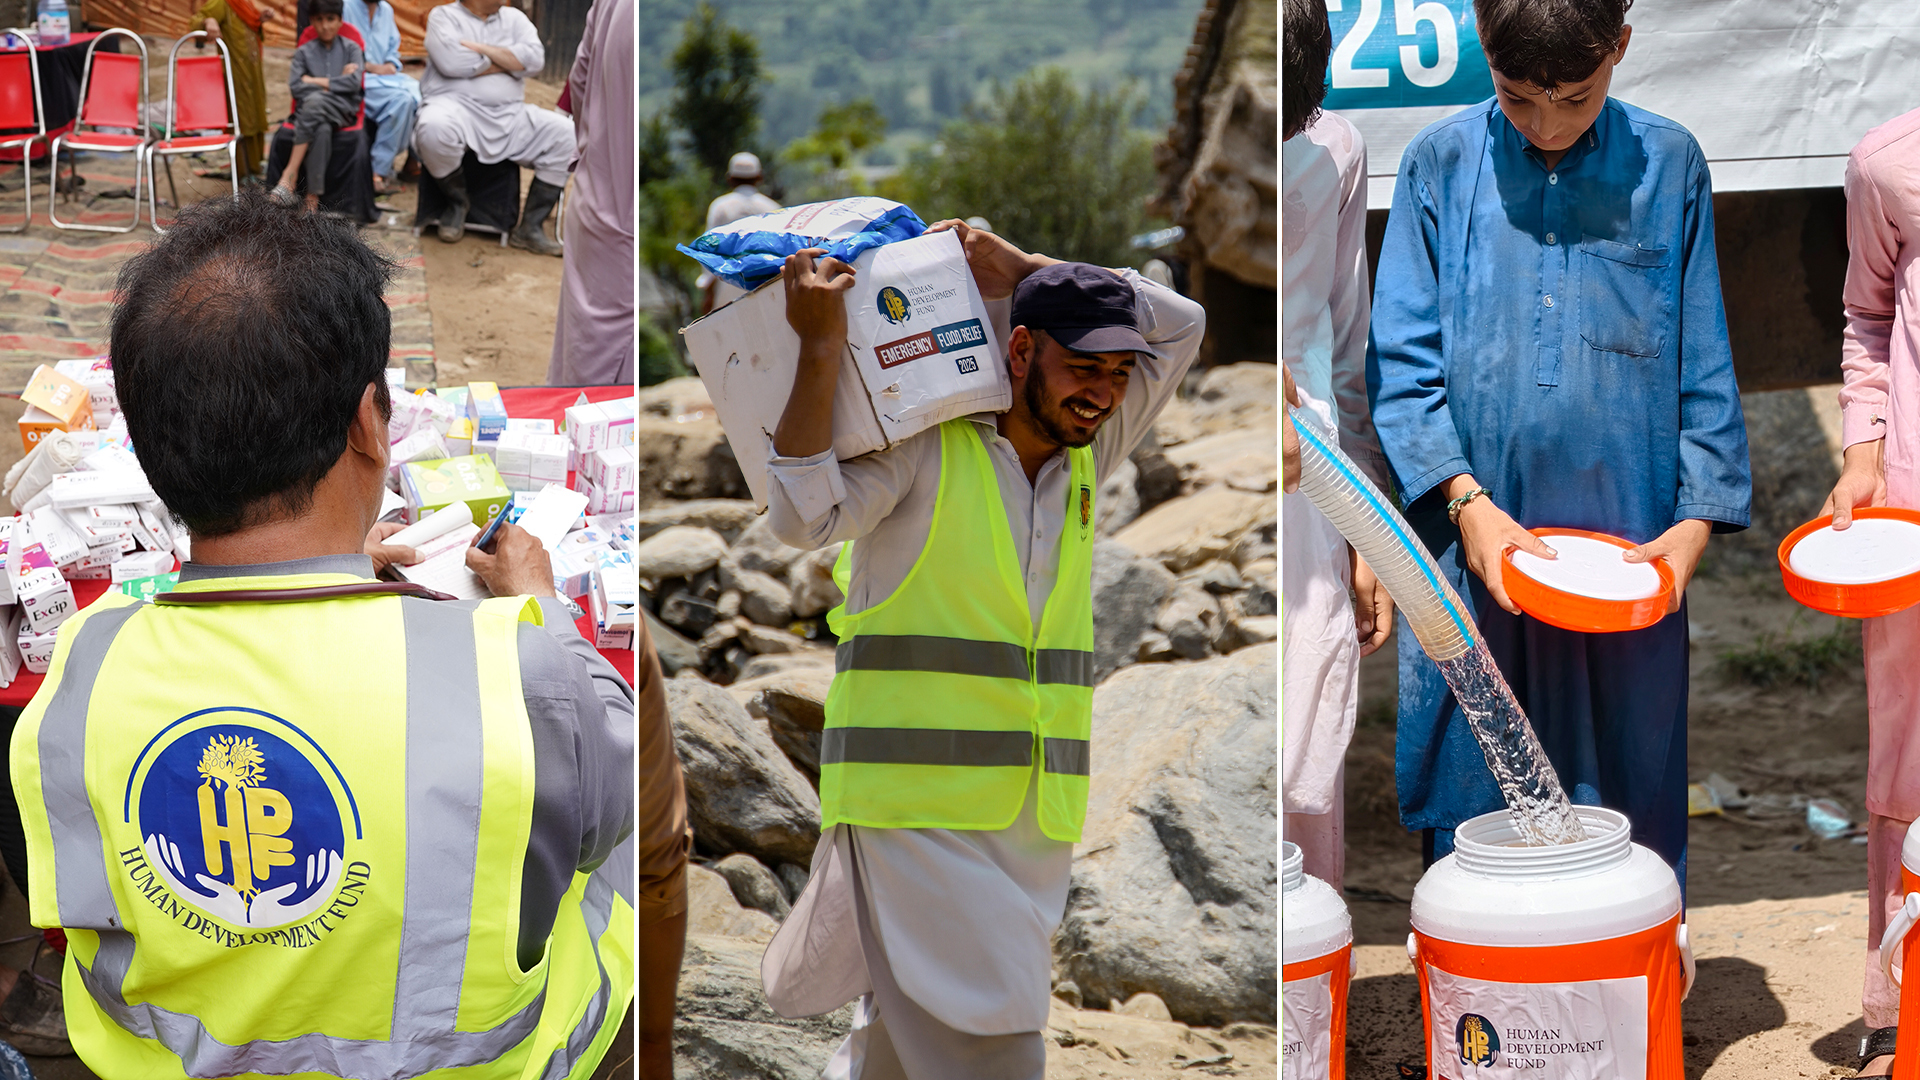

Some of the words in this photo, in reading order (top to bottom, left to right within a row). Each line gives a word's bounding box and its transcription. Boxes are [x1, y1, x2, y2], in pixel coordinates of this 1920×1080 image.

[907, 283, 935, 297] HUMAN
[911, 288, 958, 307] DEVELOPMENT
[915, 304, 936, 316] FUND
[880, 336, 934, 365] EMERGENCY
[936, 328, 962, 348] FLOOD
[960, 325, 983, 343] RELIEF
[958, 357, 977, 373] 2025
[33, 600, 68, 621] Excip
[27, 651, 52, 663] Exci
[120, 845, 184, 920] HUMAN
[181, 913, 335, 949] DEVELOPMENT
[326, 861, 371, 920] FUND
[1506, 1028, 1560, 1040] HUMAN
[1506, 1040, 1605, 1055] DEVELOPMENT
[1506, 1057, 1546, 1069] FUND
